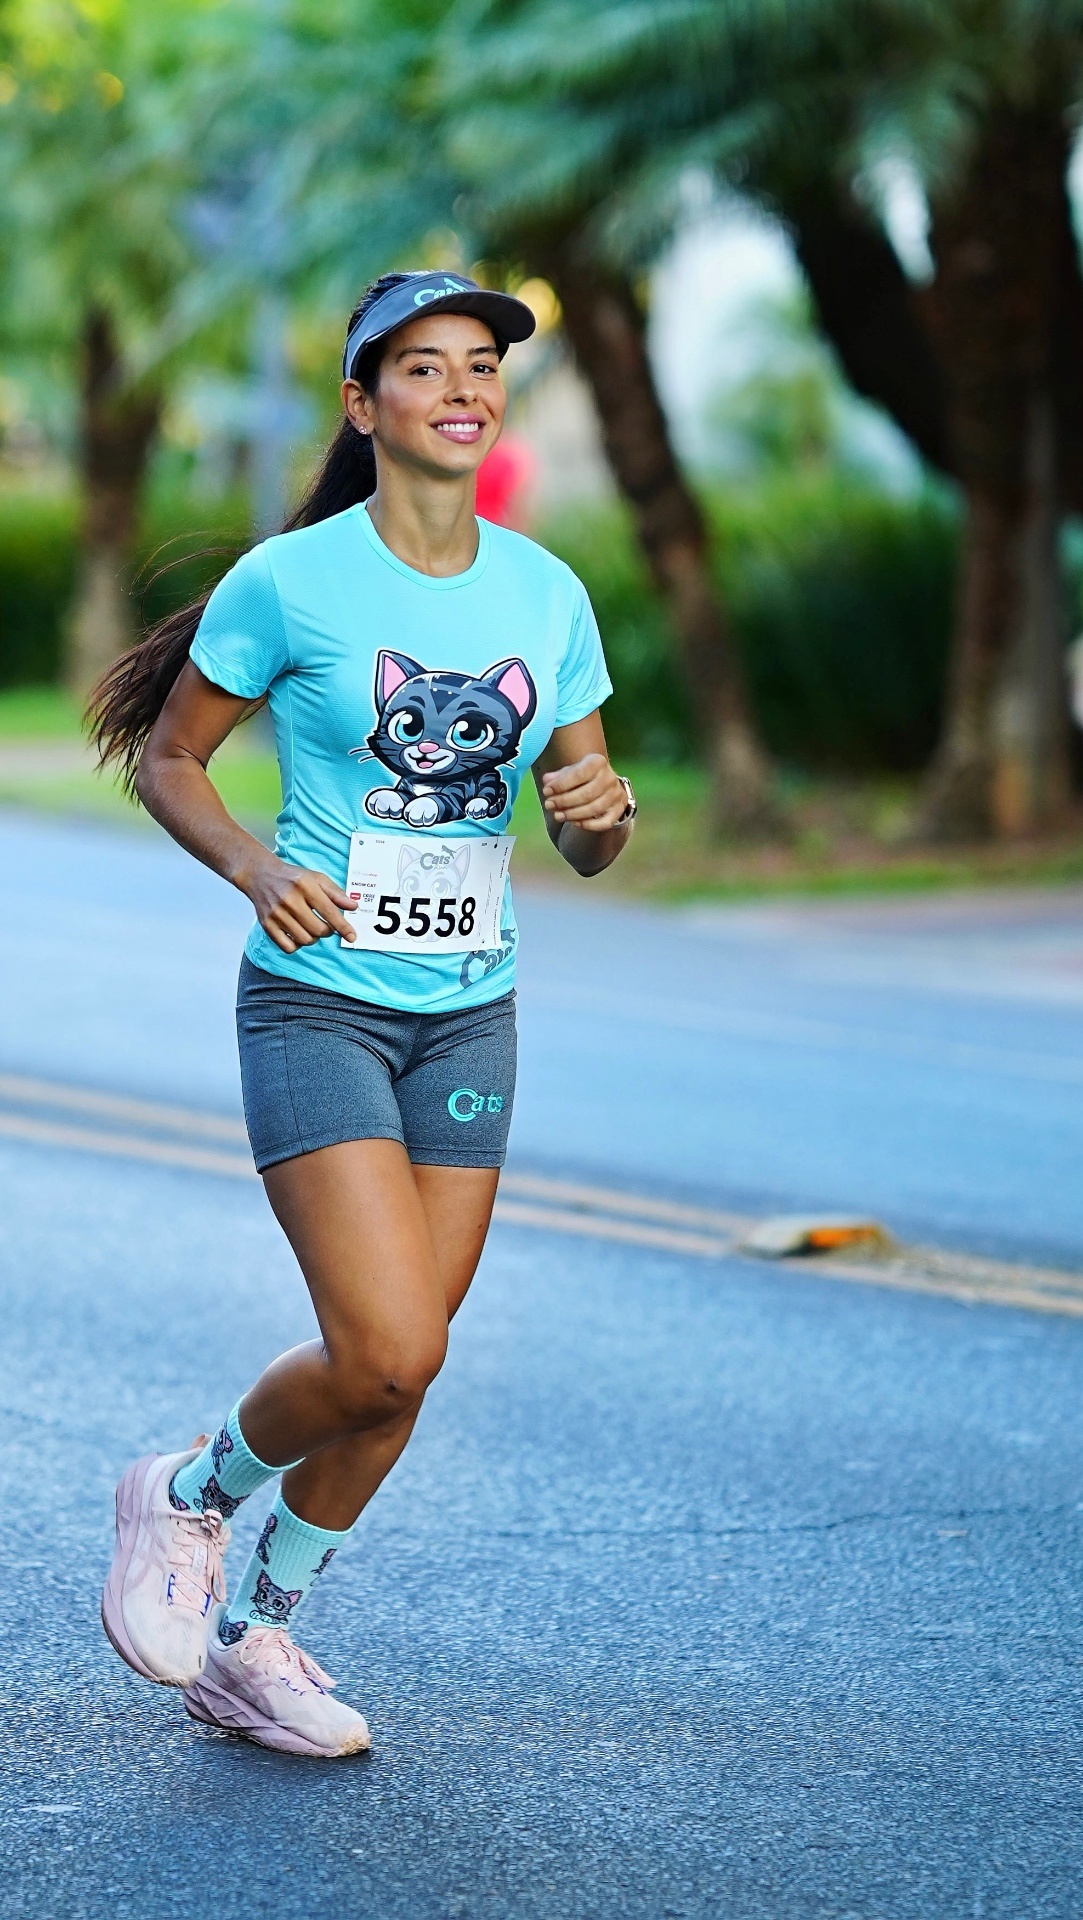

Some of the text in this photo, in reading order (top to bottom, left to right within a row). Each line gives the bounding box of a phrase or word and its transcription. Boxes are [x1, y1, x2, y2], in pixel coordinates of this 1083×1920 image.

[414, 287, 461, 307] Cat
[420, 852, 451, 870] Cats
[373, 895, 476, 937] 5558
[447, 1088, 504, 1122] Cats
